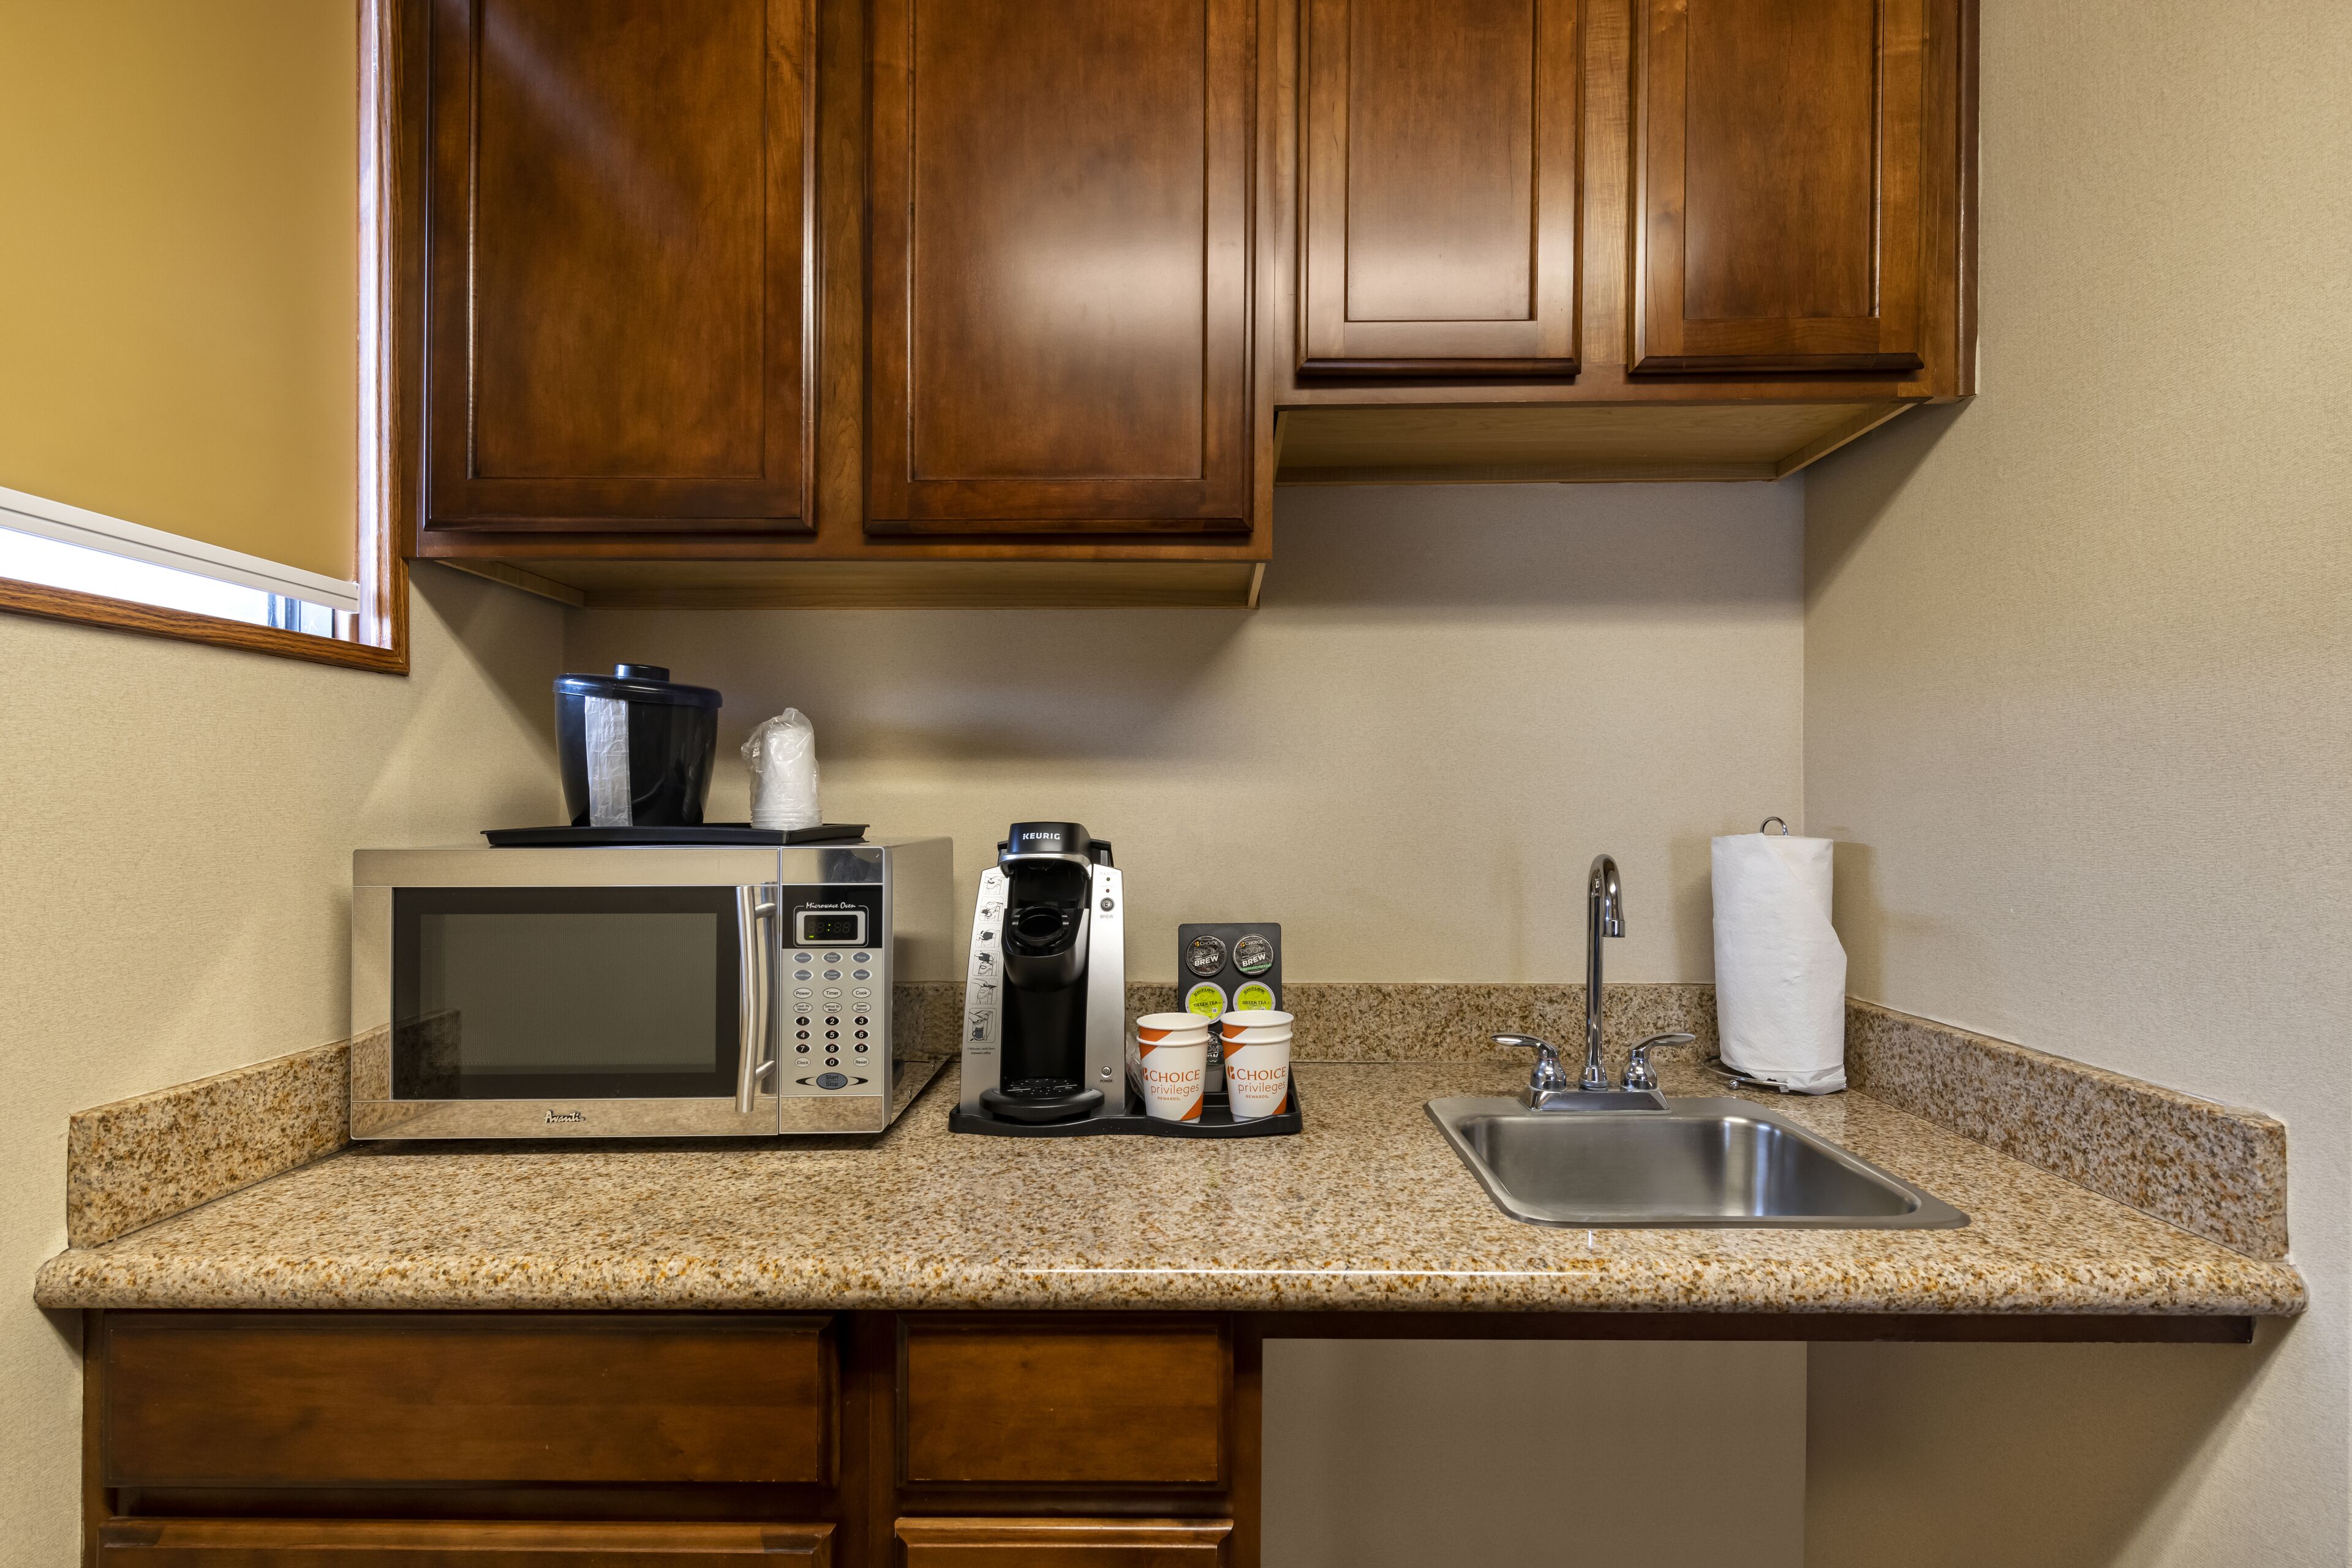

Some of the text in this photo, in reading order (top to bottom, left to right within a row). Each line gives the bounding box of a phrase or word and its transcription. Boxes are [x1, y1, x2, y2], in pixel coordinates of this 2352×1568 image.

[1240, 946, 1265, 956] ROOM
[1194, 955, 1219, 967] BREW
[1242, 953, 1266, 967] BREW
[1150, 1069, 1200, 1083] CHOICE
[1237, 1066, 1286, 1080] CHOICE
[1151, 1084, 1199, 1096] privileges
[1238, 1081, 1286, 1095] privileges
[544, 1110, 580, 1123] Avanti
